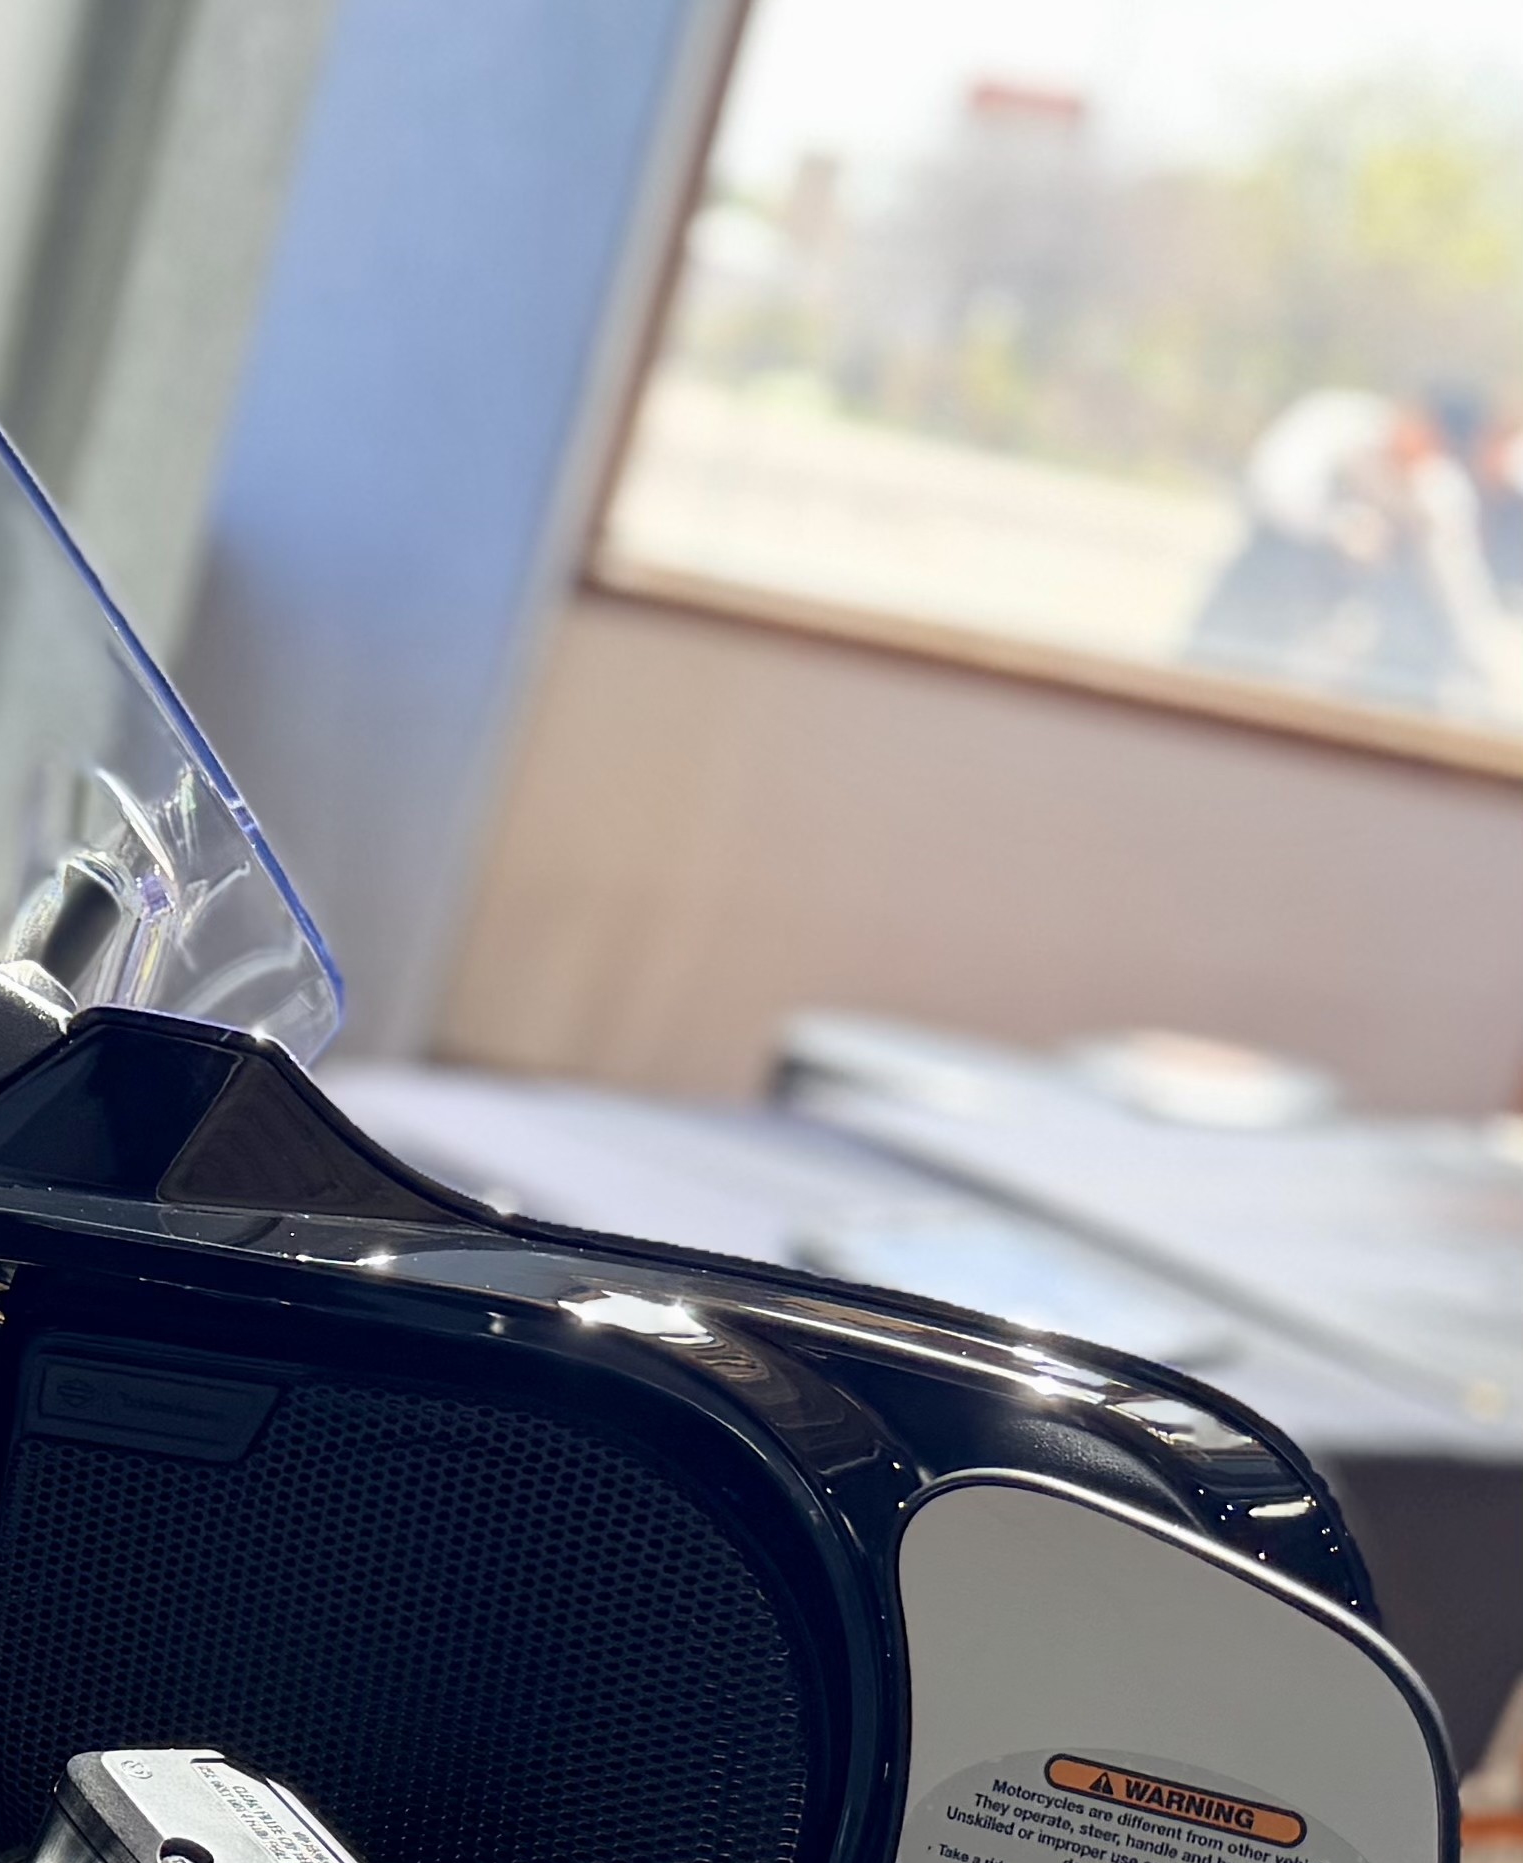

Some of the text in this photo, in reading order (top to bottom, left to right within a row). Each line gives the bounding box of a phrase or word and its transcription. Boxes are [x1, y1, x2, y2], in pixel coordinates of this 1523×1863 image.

[974, 1793, 1007, 1816] They
[1013, 1806, 1074, 1834] operate,
[1079, 1823, 1120, 1847] steer,
[1125, 1834, 1177, 1859] handle
[992, 1778, 1085, 1814] Motorcycles
[1088, 1807, 1113, 1822] are
[1117, 1812, 1183, 1841] different
[1186, 1829, 1223, 1851] from
[1228, 1842, 1271, 1862] other
[1125, 1778, 1255, 1830] WARNING
[939, 1844, 969, 1863] Take
[946, 1805, 1015, 1836] Unskilled
[1017, 1828, 1035, 1840] or
[1038, 1829, 1107, 1861] improper
